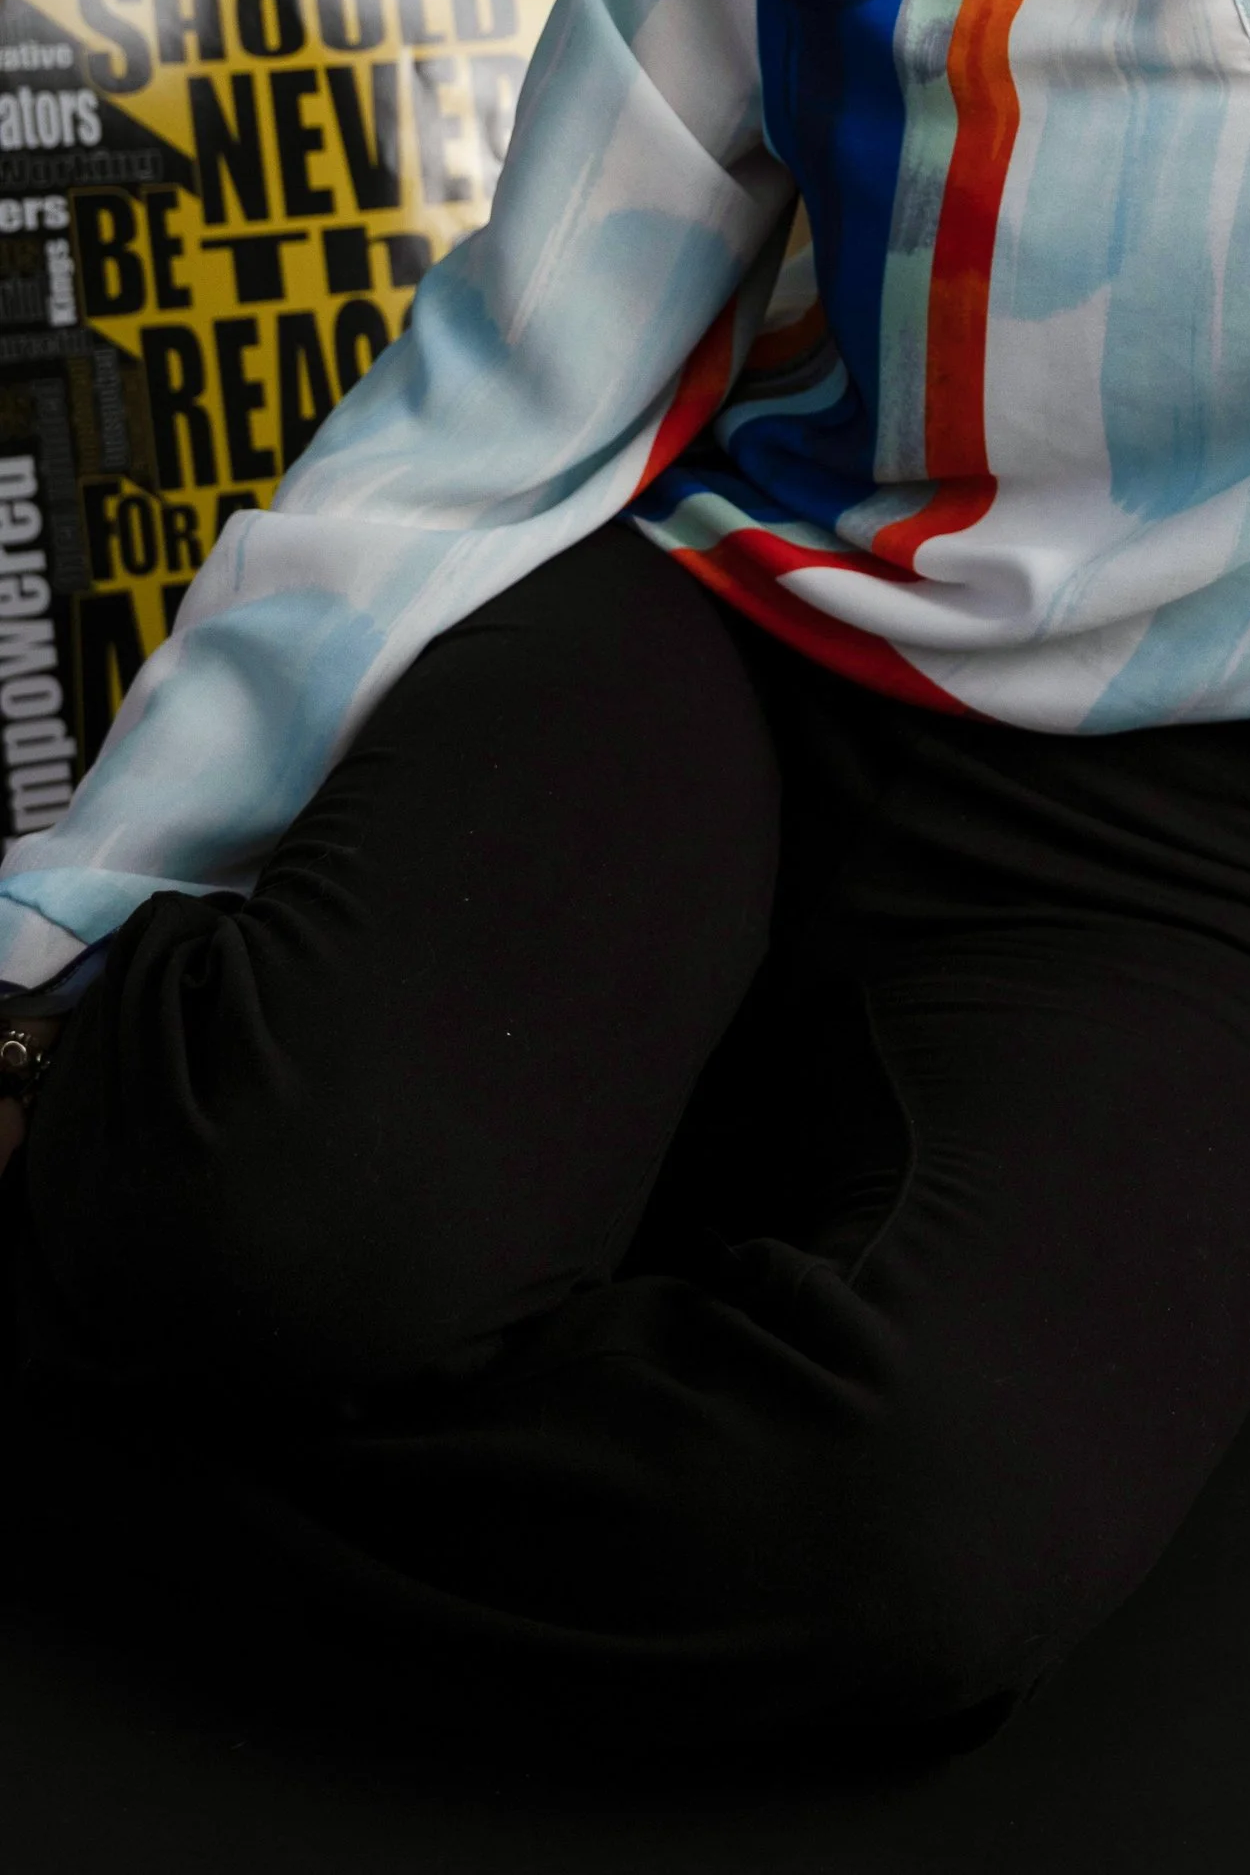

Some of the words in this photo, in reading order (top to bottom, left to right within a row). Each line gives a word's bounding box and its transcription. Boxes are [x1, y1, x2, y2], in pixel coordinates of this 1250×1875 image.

[0, 42, 72, 71] ative
[75, 190, 193, 317] BE
[201, 227, 466, 302] Th
[141, 299, 412, 487] REA
[84, 483, 203, 581] FOR
[0, 454, 77, 839] mpowere
